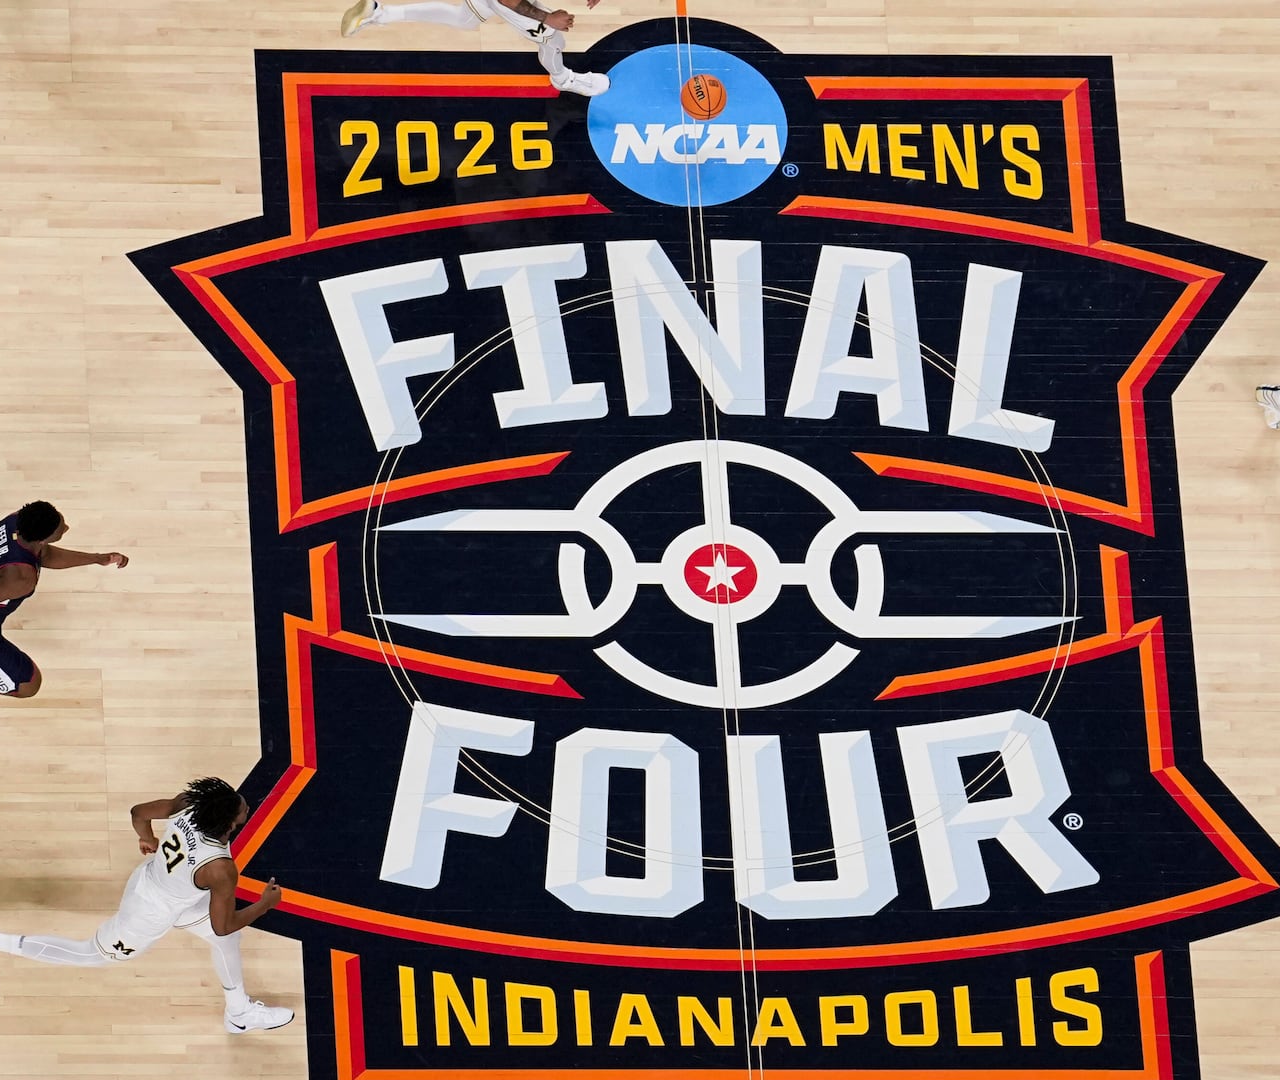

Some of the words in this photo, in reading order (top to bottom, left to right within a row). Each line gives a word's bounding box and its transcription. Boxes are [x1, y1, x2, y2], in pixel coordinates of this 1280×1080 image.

[340, 121, 552, 196] 2026
[824, 124, 1042, 199] MEN'S
[610, 123, 782, 165] NCAA
[320, 240, 1055, 453] FINAL
[174, 816, 197, 851] JOHNSON
[379, 702, 1100, 920] FOUR
[162, 833, 185, 874] 21
[399, 967, 1102, 1047] INDIANAPOLIS
